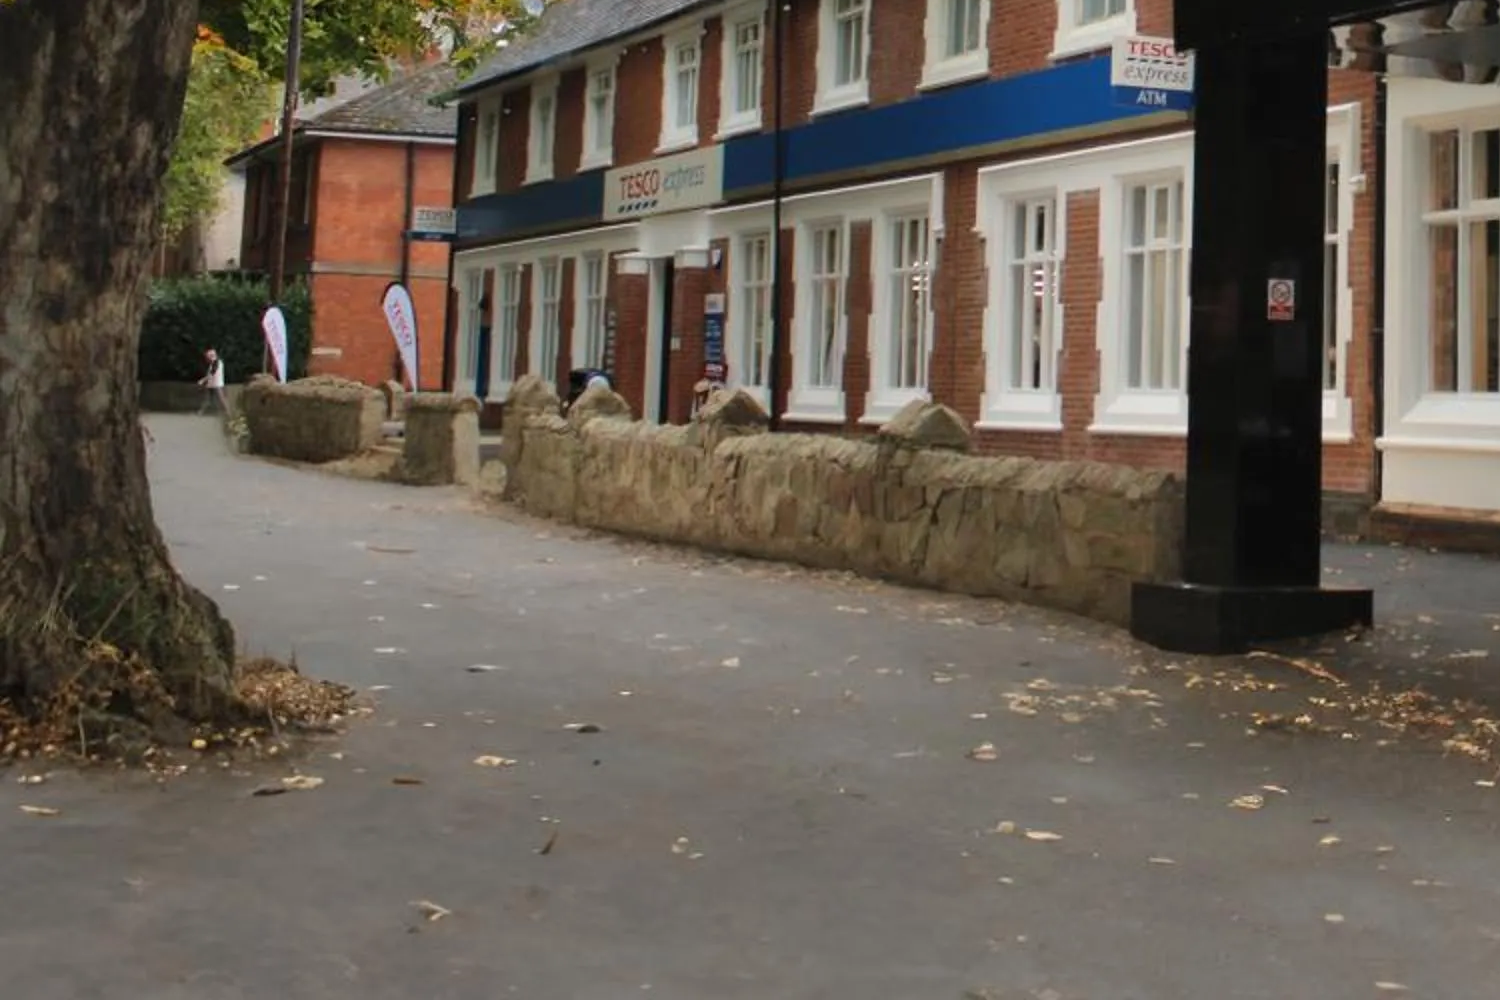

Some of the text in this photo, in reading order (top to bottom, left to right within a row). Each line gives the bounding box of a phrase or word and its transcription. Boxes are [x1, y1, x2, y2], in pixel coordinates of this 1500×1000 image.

[1124, 65, 1188, 84] express
[1135, 89, 1168, 106] ATM
[619, 168, 660, 201] TESCO
